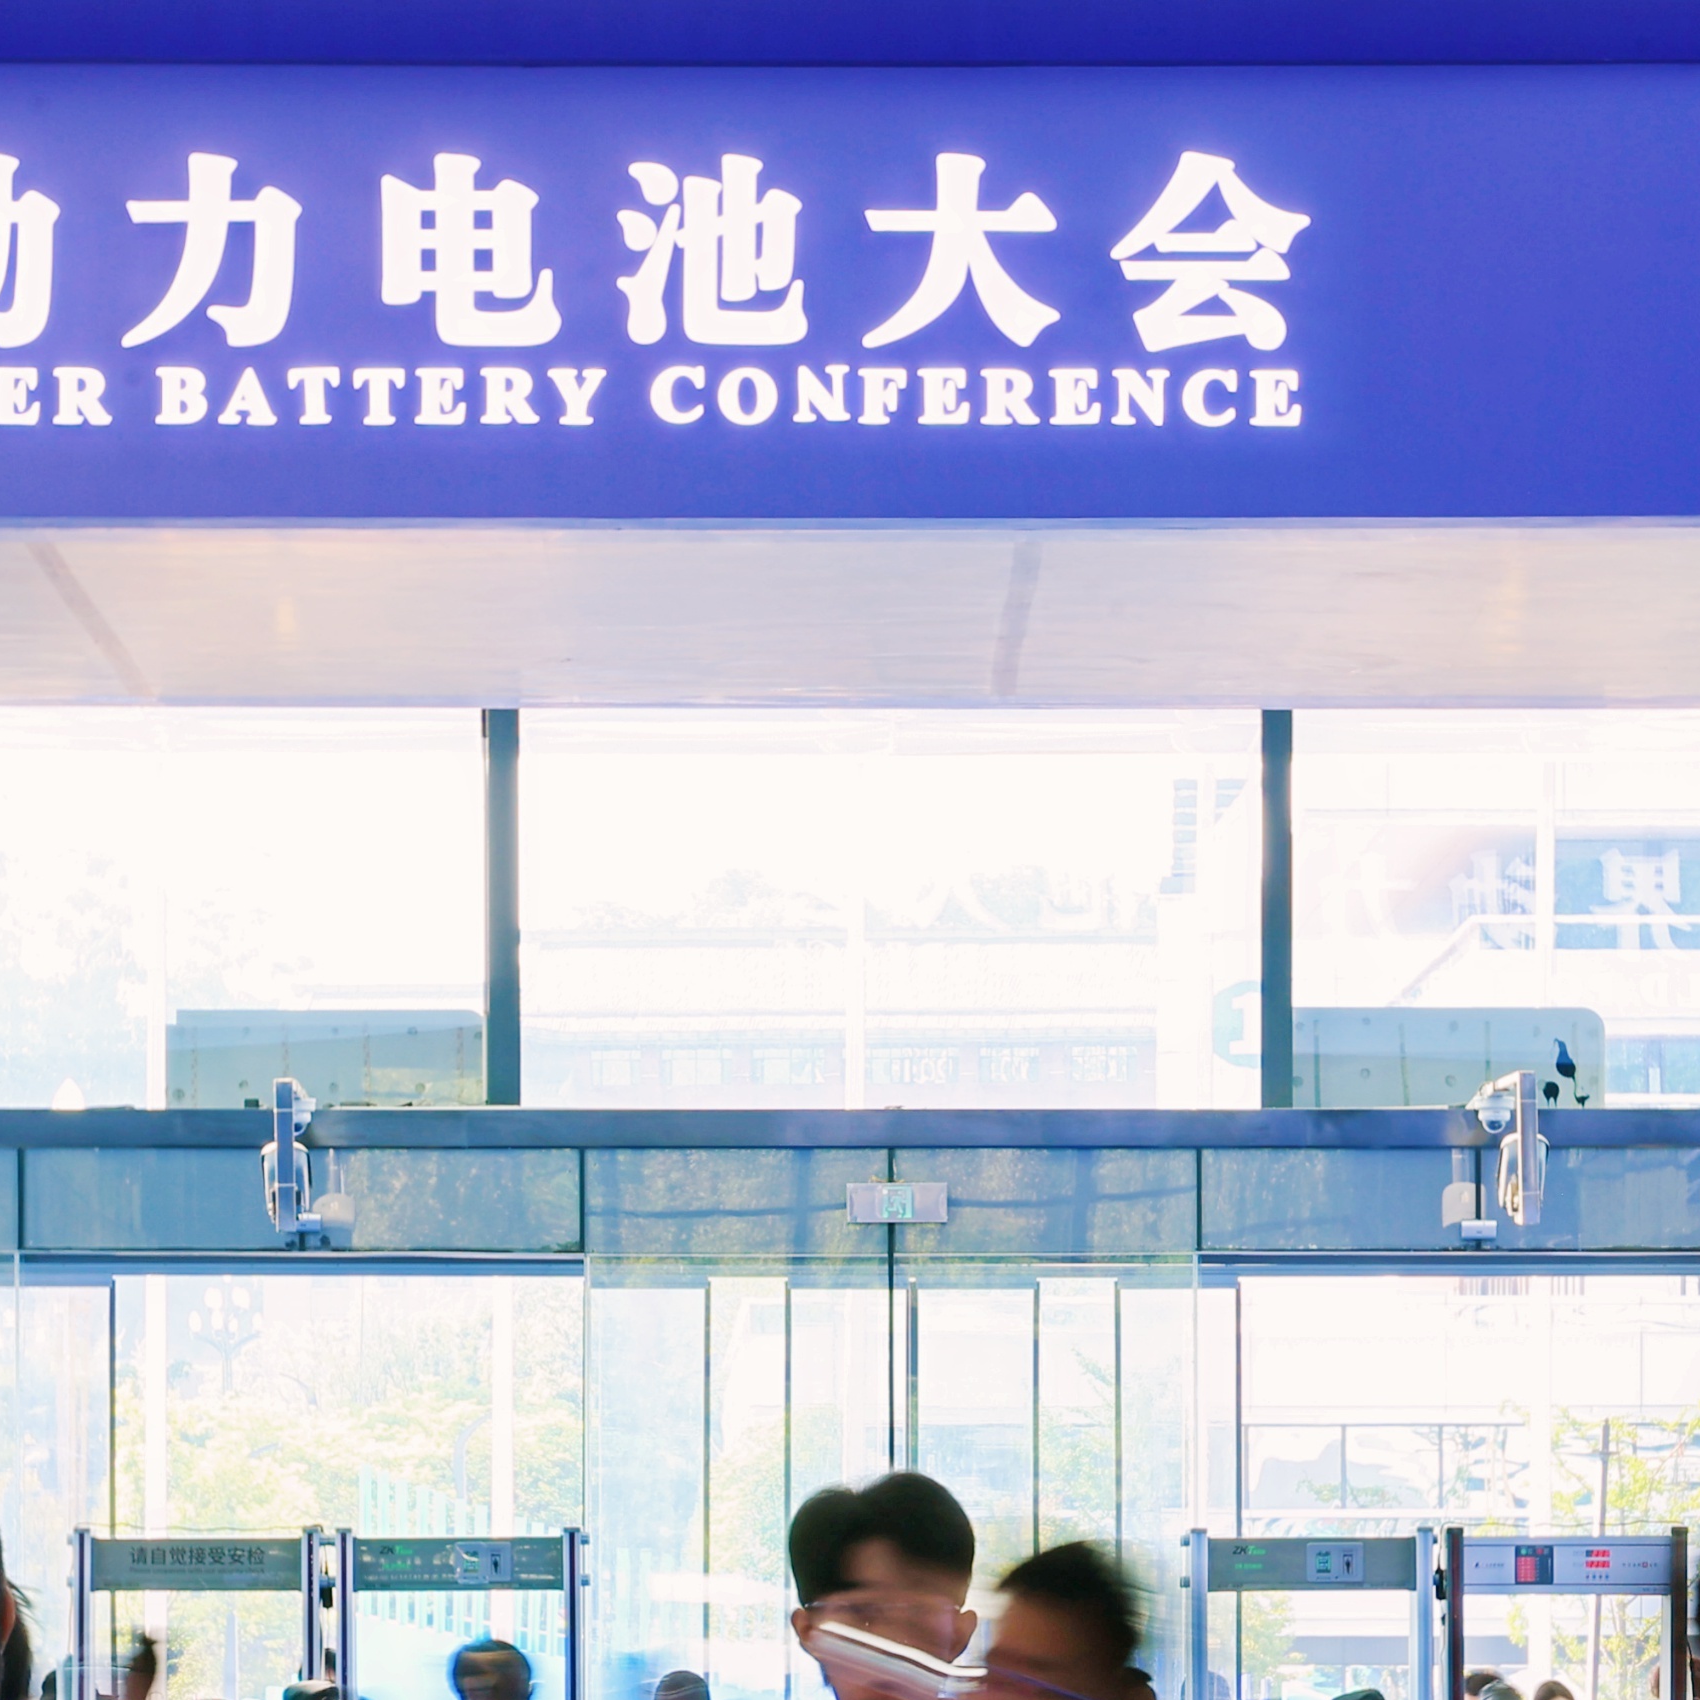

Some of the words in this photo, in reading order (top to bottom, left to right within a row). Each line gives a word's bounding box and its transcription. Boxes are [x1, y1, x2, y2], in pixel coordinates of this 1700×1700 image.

[155, 363, 608, 427] BATTERY
[649, 363, 1302, 428] CONFERENCE
[129, 1545, 266, 1565] 请自觉接受安检
